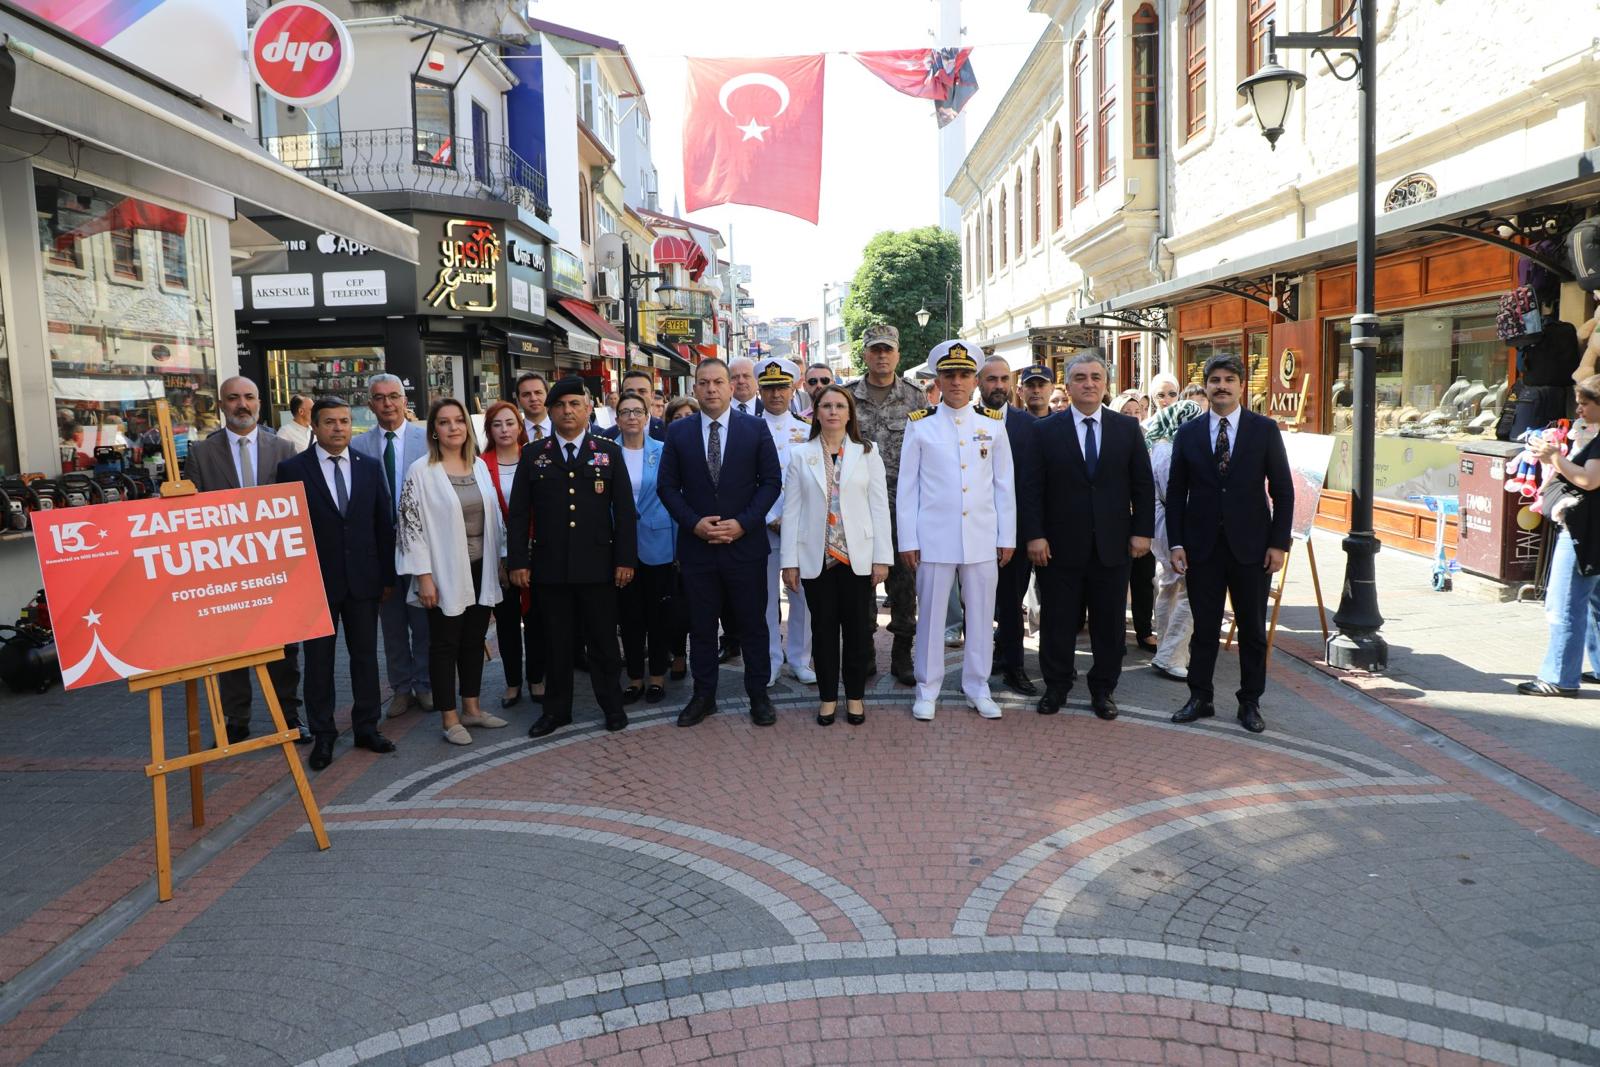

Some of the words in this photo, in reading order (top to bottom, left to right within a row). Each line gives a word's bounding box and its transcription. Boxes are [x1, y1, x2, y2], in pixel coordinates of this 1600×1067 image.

[262, 32, 333, 72] dyo
[255, 287, 310, 298] AKSESUAR
[331, 288, 380, 298] TELEFONU
[346, 279, 364, 287] CEP
[128, 502, 248, 538] ZAFERİN
[255, 496, 299, 521] ADI
[133, 526, 307, 580] TÜRKİYE
[172, 581, 238, 602] FOTOĞRAF
[241, 571, 288, 590] SERGİSİ
[198, 607, 209, 617] 15
[211, 601, 250, 615] TEMMUZ
[252, 596, 273, 608] 2025
